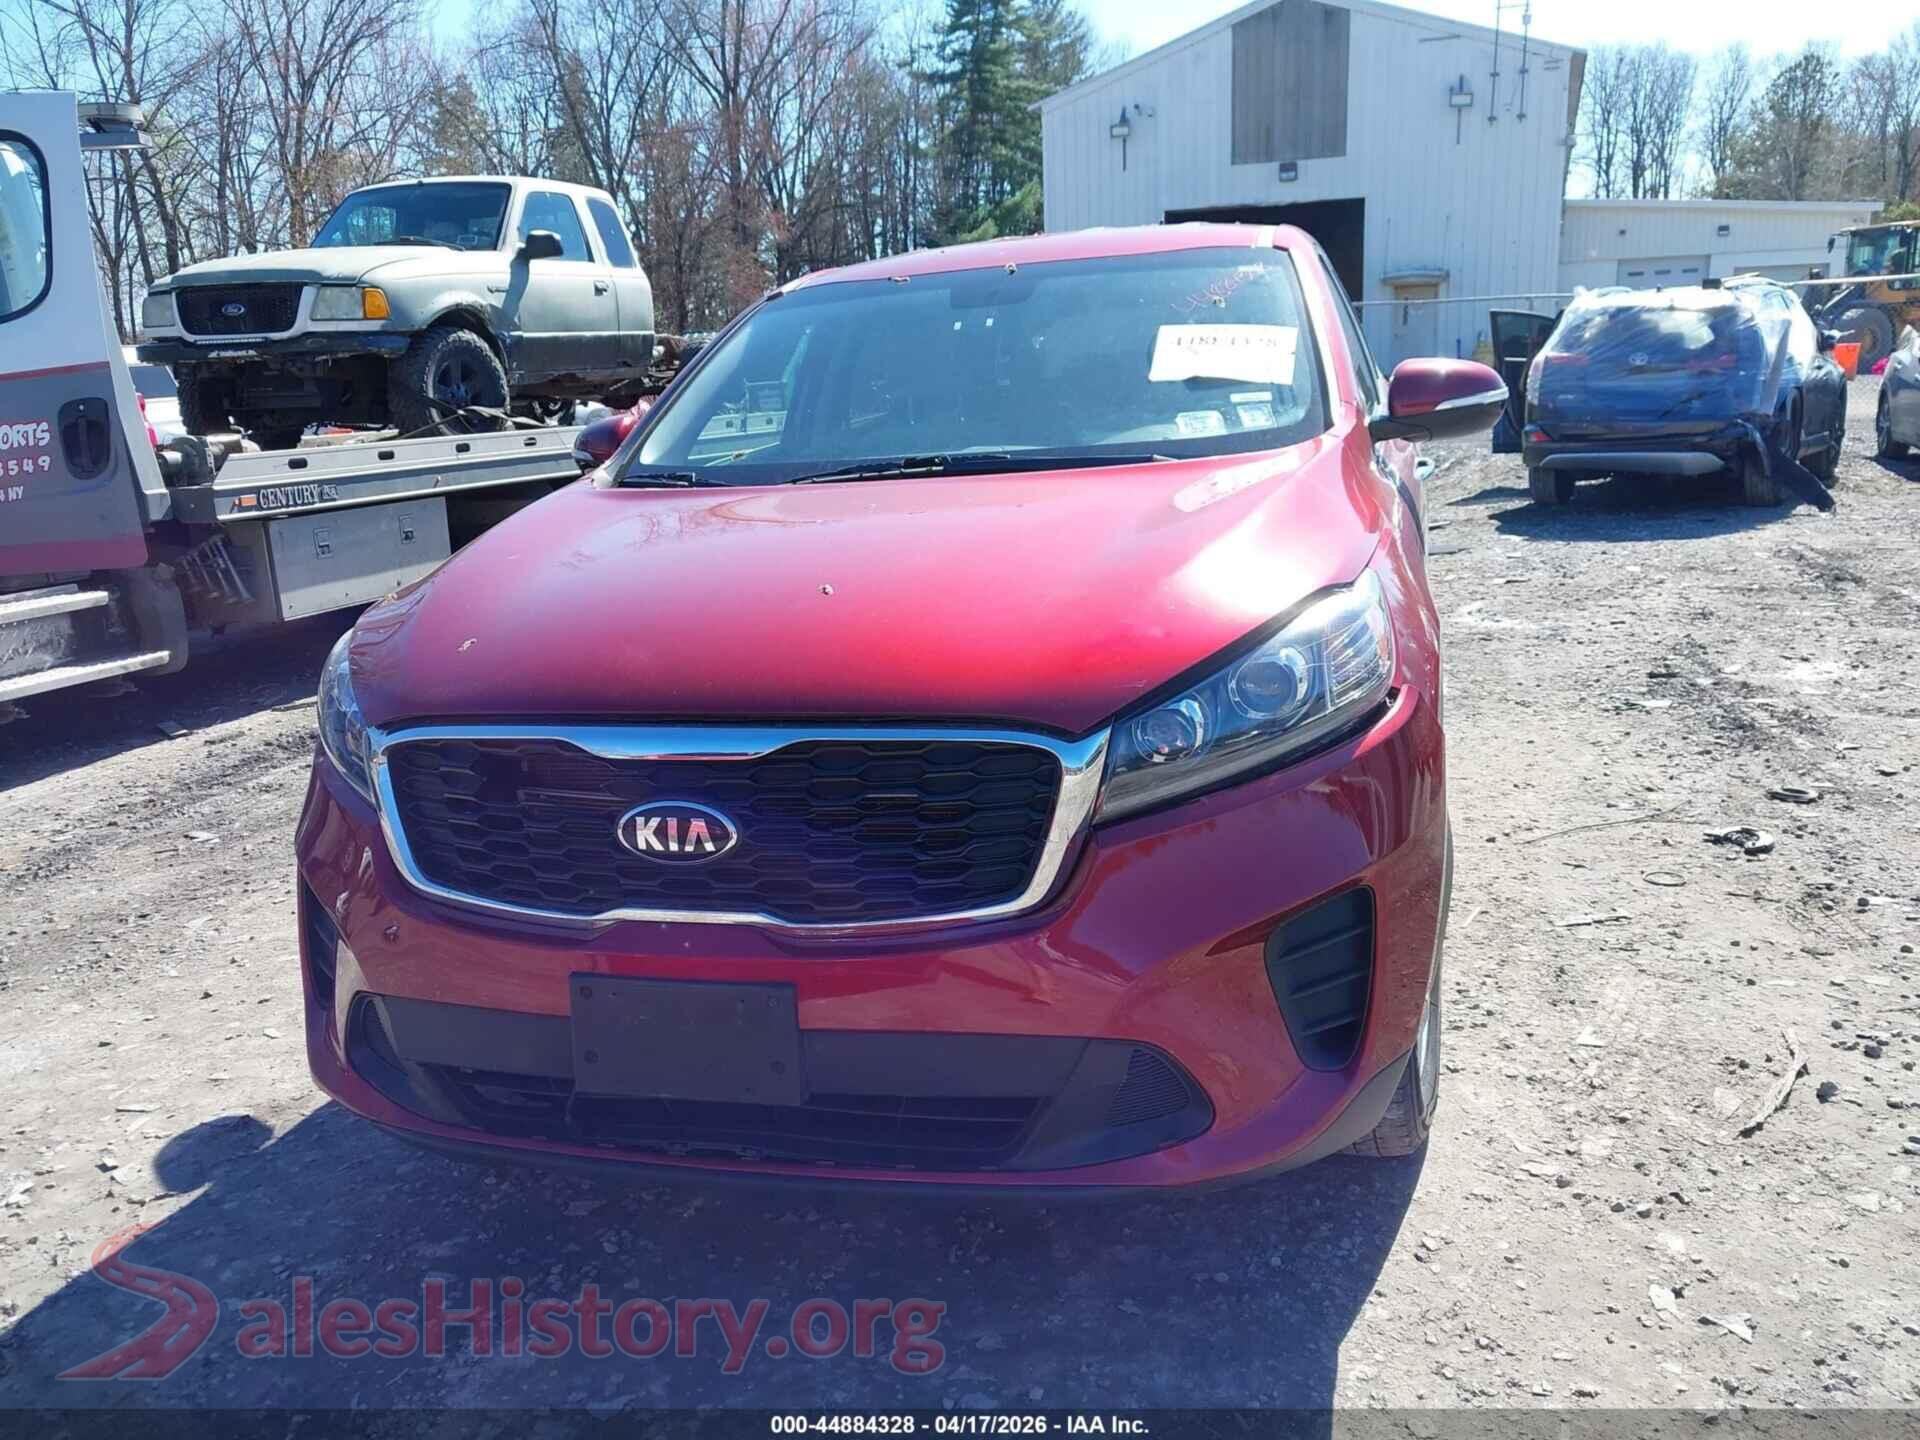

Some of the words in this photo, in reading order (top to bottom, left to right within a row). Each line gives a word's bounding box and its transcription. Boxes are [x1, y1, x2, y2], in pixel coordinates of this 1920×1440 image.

[0, 422, 50, 450] ORTS
[258, 483, 320, 509] CENTURY
[635, 816, 717, 852] KIA
